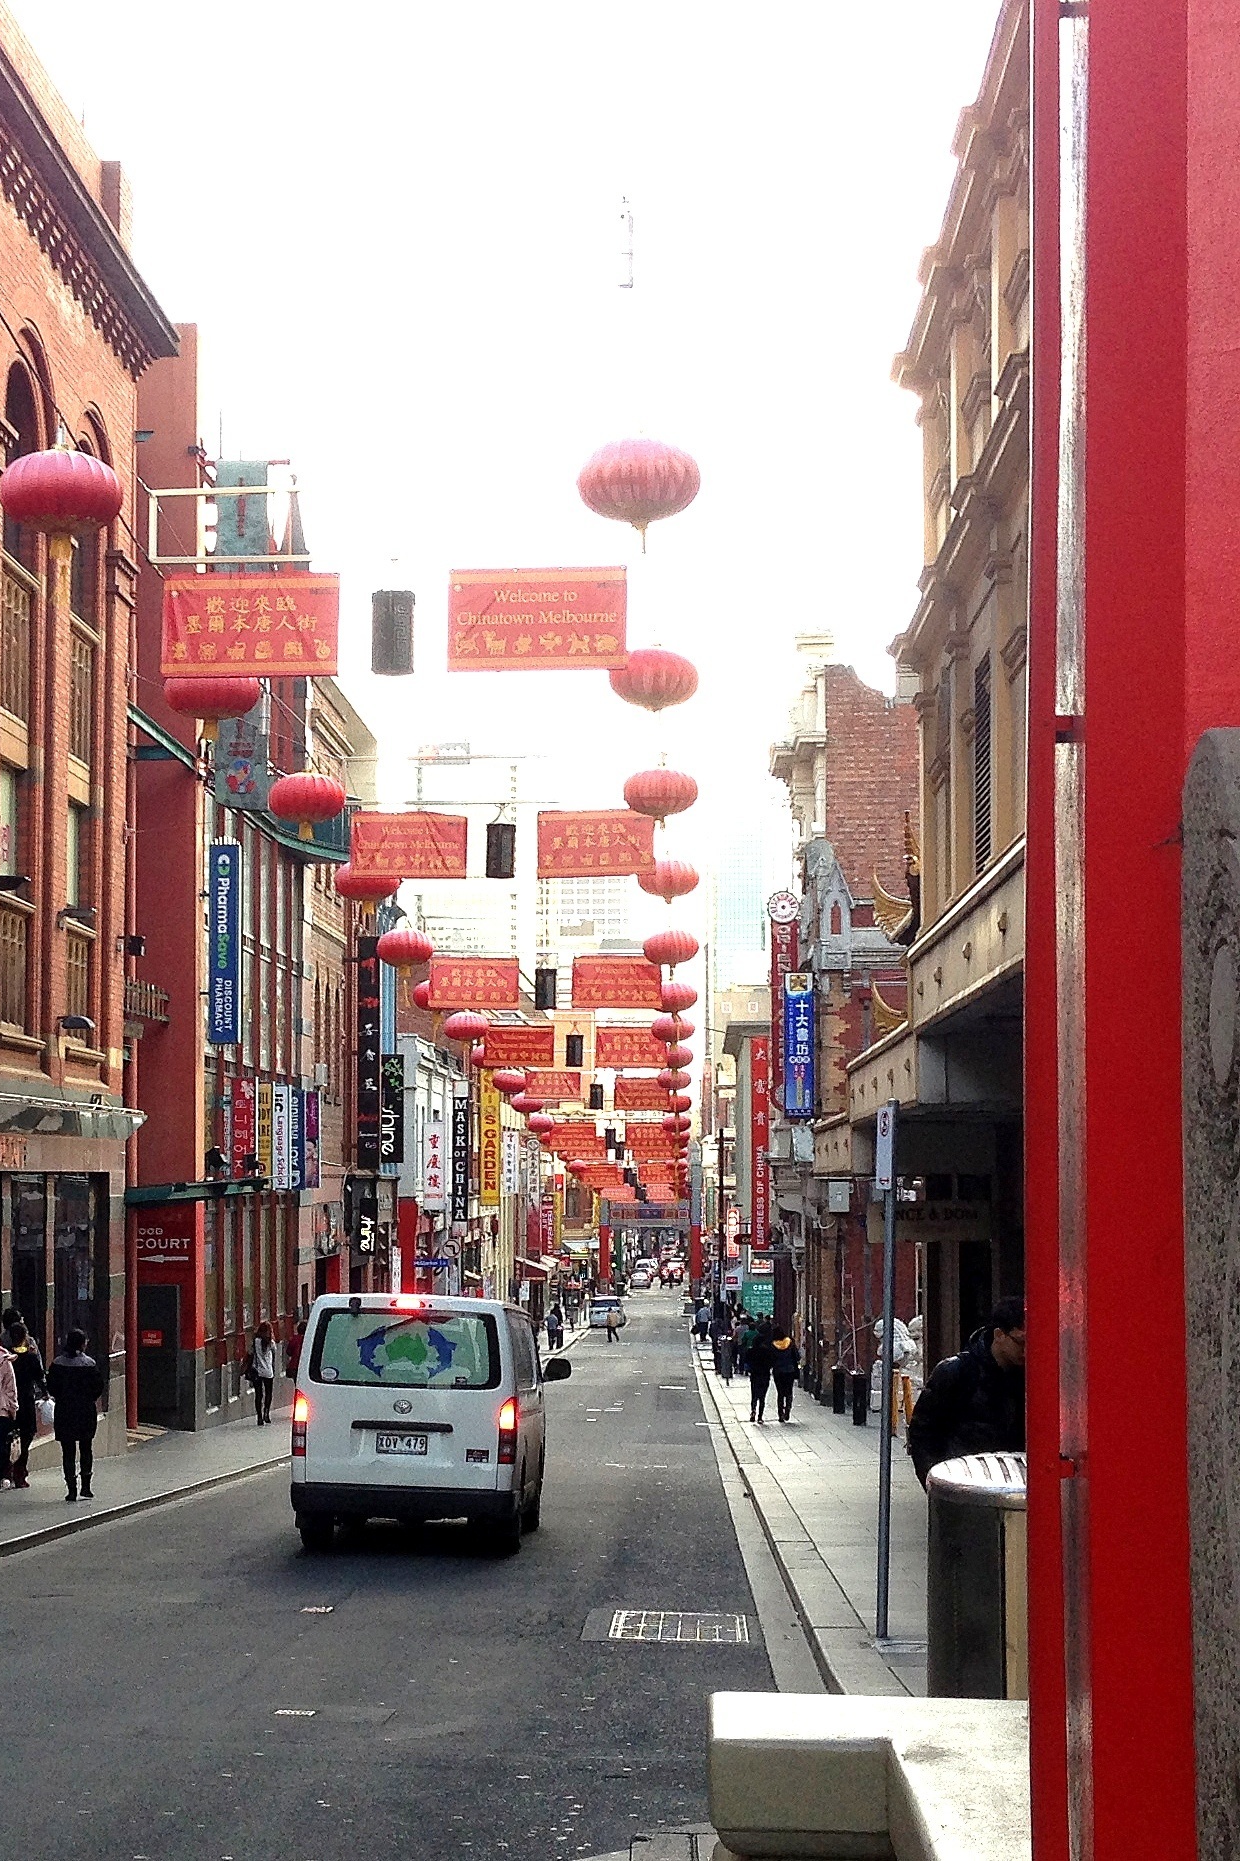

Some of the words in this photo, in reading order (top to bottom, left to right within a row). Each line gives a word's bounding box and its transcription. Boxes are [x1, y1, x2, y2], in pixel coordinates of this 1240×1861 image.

[494, 589, 559, 603] Welcome
[563, 591, 578, 602] to
[457, 610, 534, 626] Chinatown
[539, 609, 618, 624] Melbourne
[454, 1098, 468, 1147] MASK
[276, 1115, 285, 1156] Language
[483, 1128, 497, 1191] GARDEN
[276, 1158, 285, 1186] School
[454, 1161, 466, 1220] CHINA
[138, 1227, 164, 1236] OOD
[136, 1238, 191, 1249] COURT
[405, 1437, 425, 1450] 479
